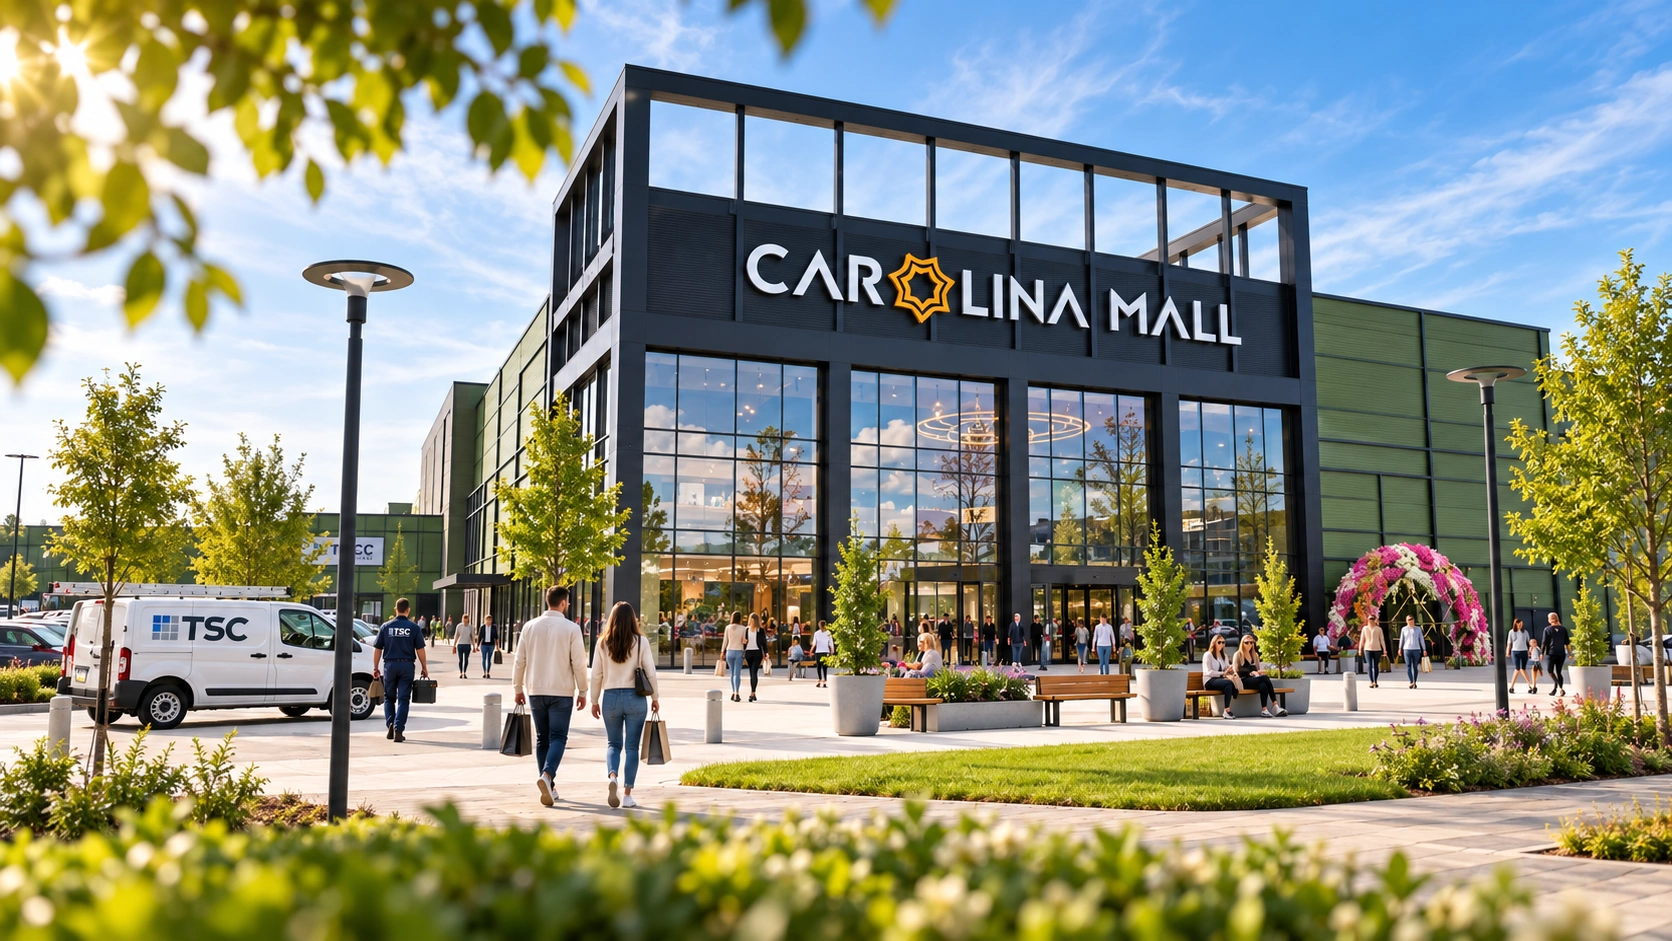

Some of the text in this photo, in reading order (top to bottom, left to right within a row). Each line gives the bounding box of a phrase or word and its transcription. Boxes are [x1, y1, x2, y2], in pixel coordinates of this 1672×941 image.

[1110, 288, 1242, 345] MALL
[182, 616, 249, 641] TSC
[394, 628, 411, 636] TSC
